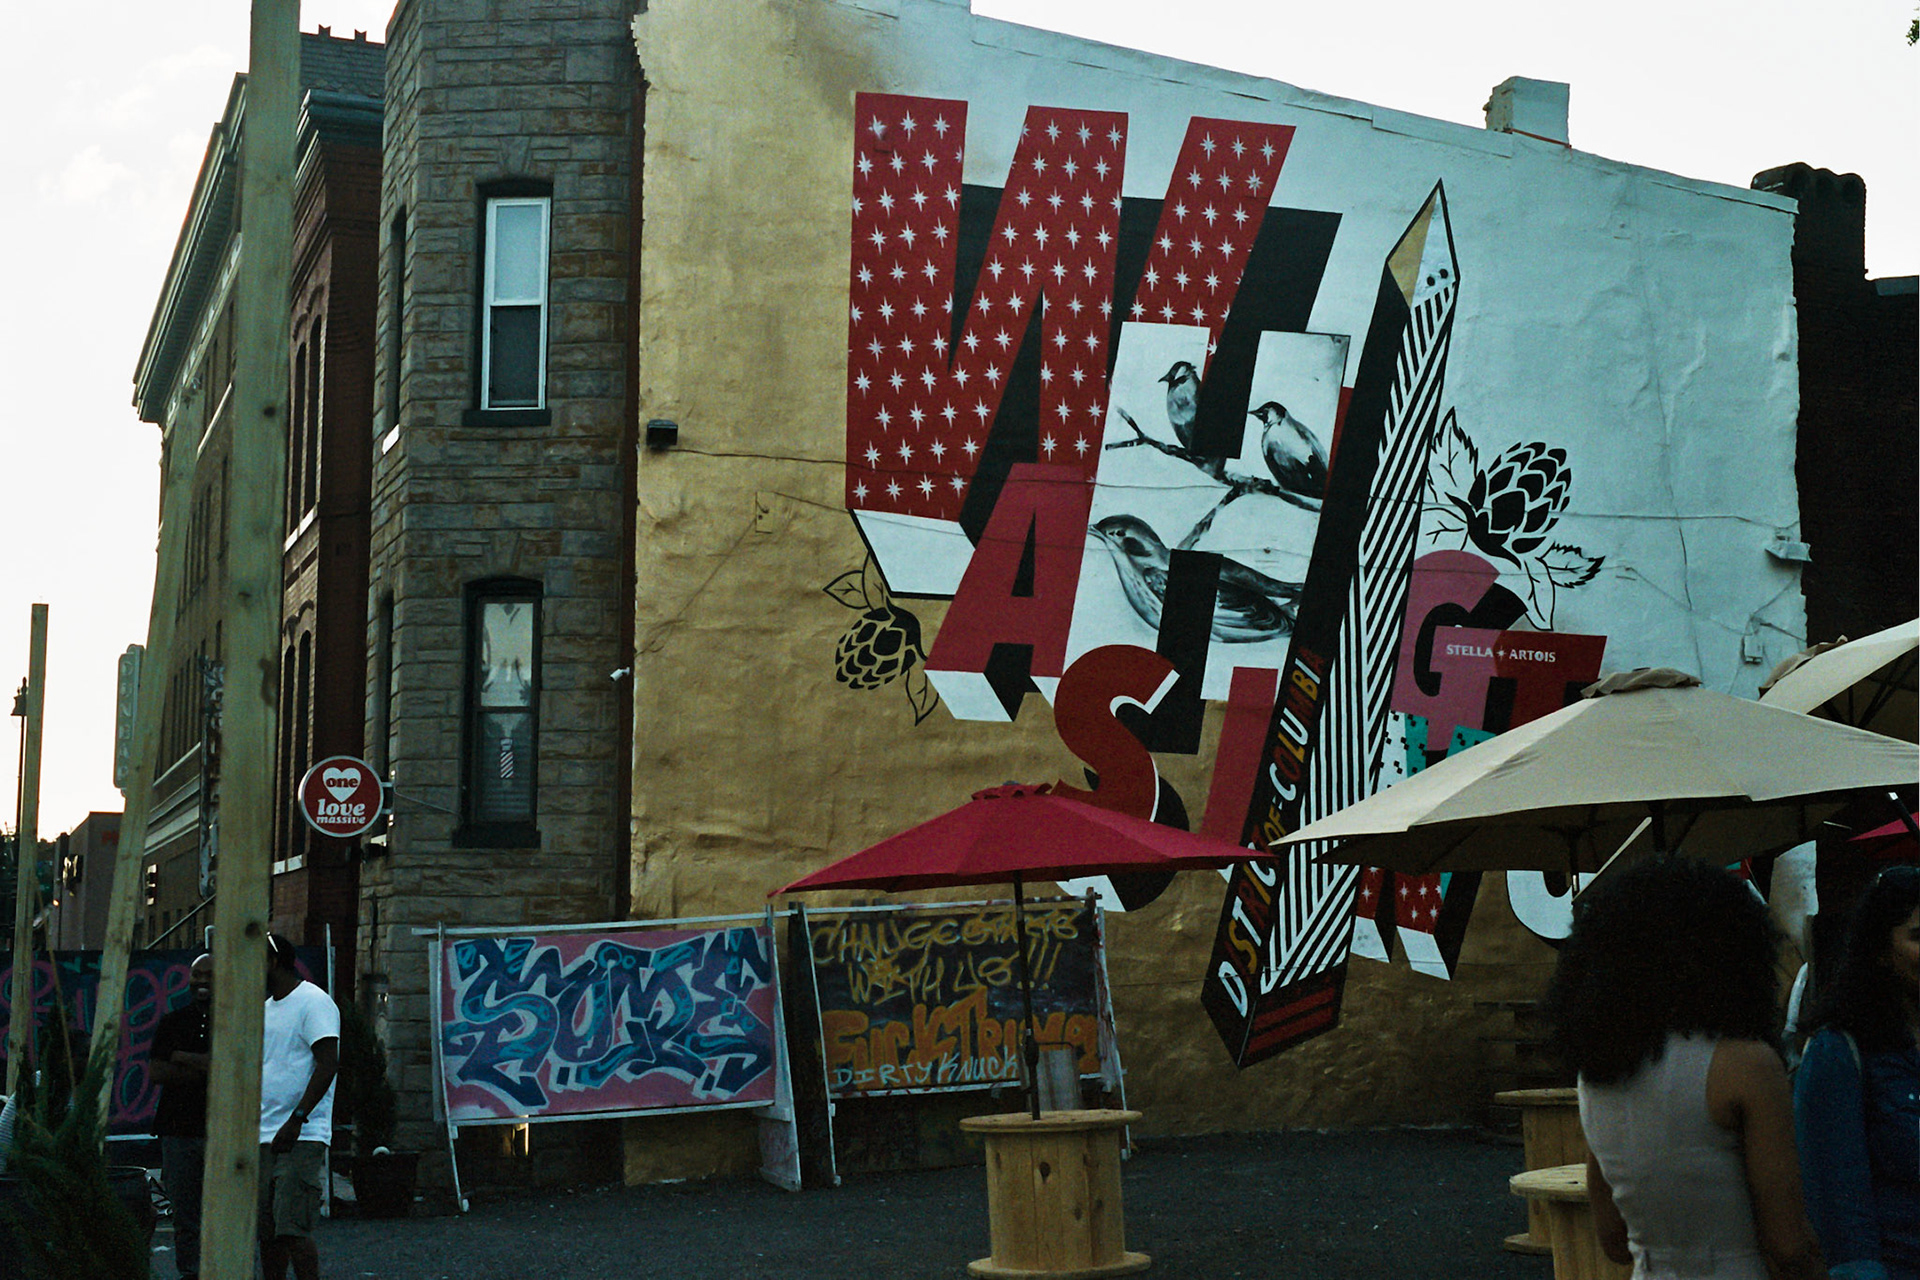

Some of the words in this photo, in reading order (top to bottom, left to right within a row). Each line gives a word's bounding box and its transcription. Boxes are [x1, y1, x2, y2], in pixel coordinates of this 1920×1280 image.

[1446, 644, 1494, 658] STELLA
[1509, 649, 1556, 662] ARTOIS
[1269, 647, 1326, 801] COLUMBIA
[325, 777, 359, 788] one
[317, 798, 366, 816] love
[316, 815, 366, 824] massive
[832, 1058, 933, 1086] DIRTY
